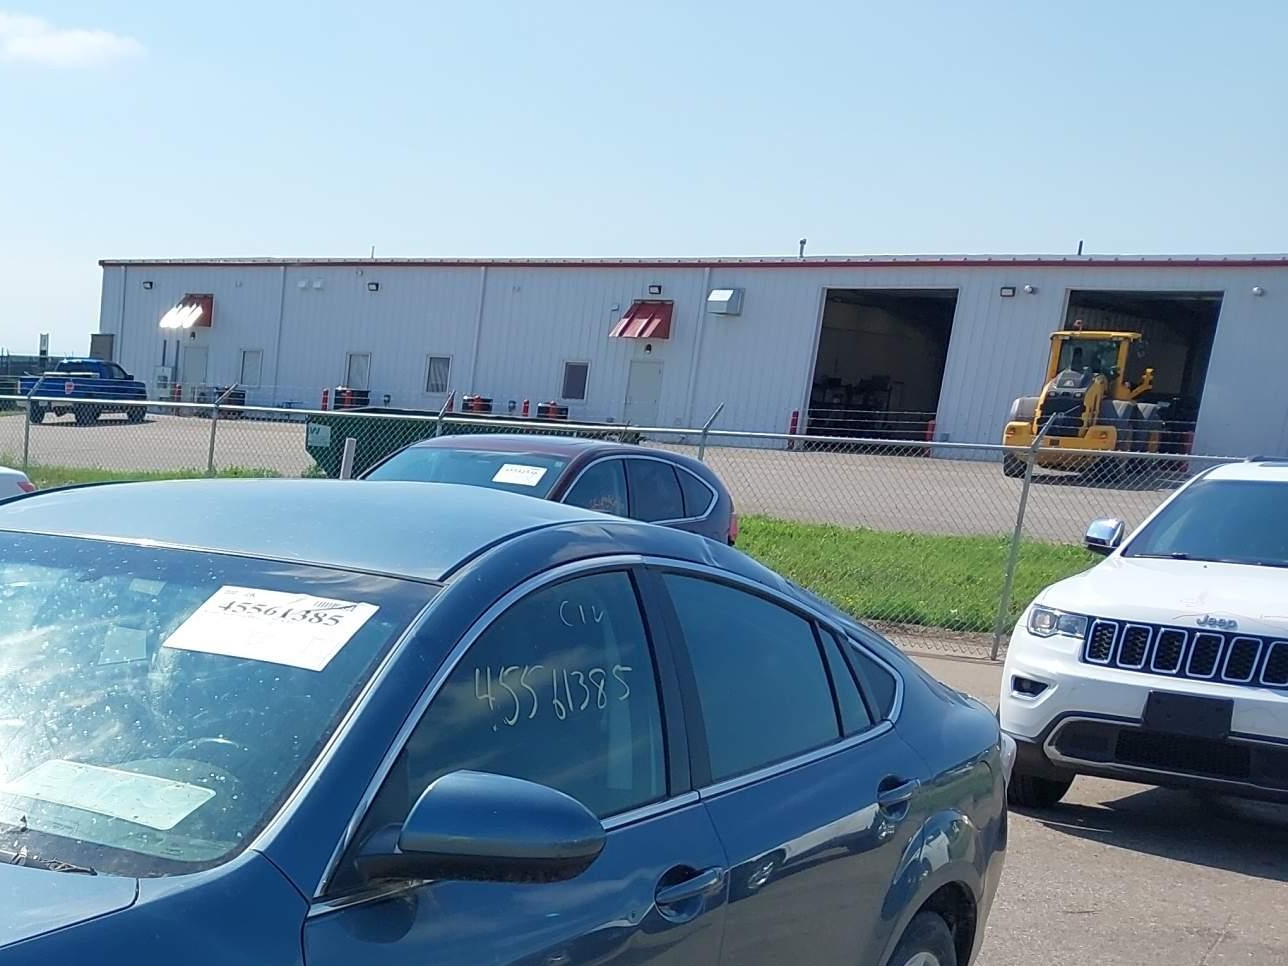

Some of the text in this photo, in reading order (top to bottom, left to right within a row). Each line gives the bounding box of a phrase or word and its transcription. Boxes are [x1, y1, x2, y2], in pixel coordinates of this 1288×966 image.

[218, 600, 344, 627] 45561385
[1196, 614, 1238, 630] Jeep
[475, 665, 632, 726] 45561385
